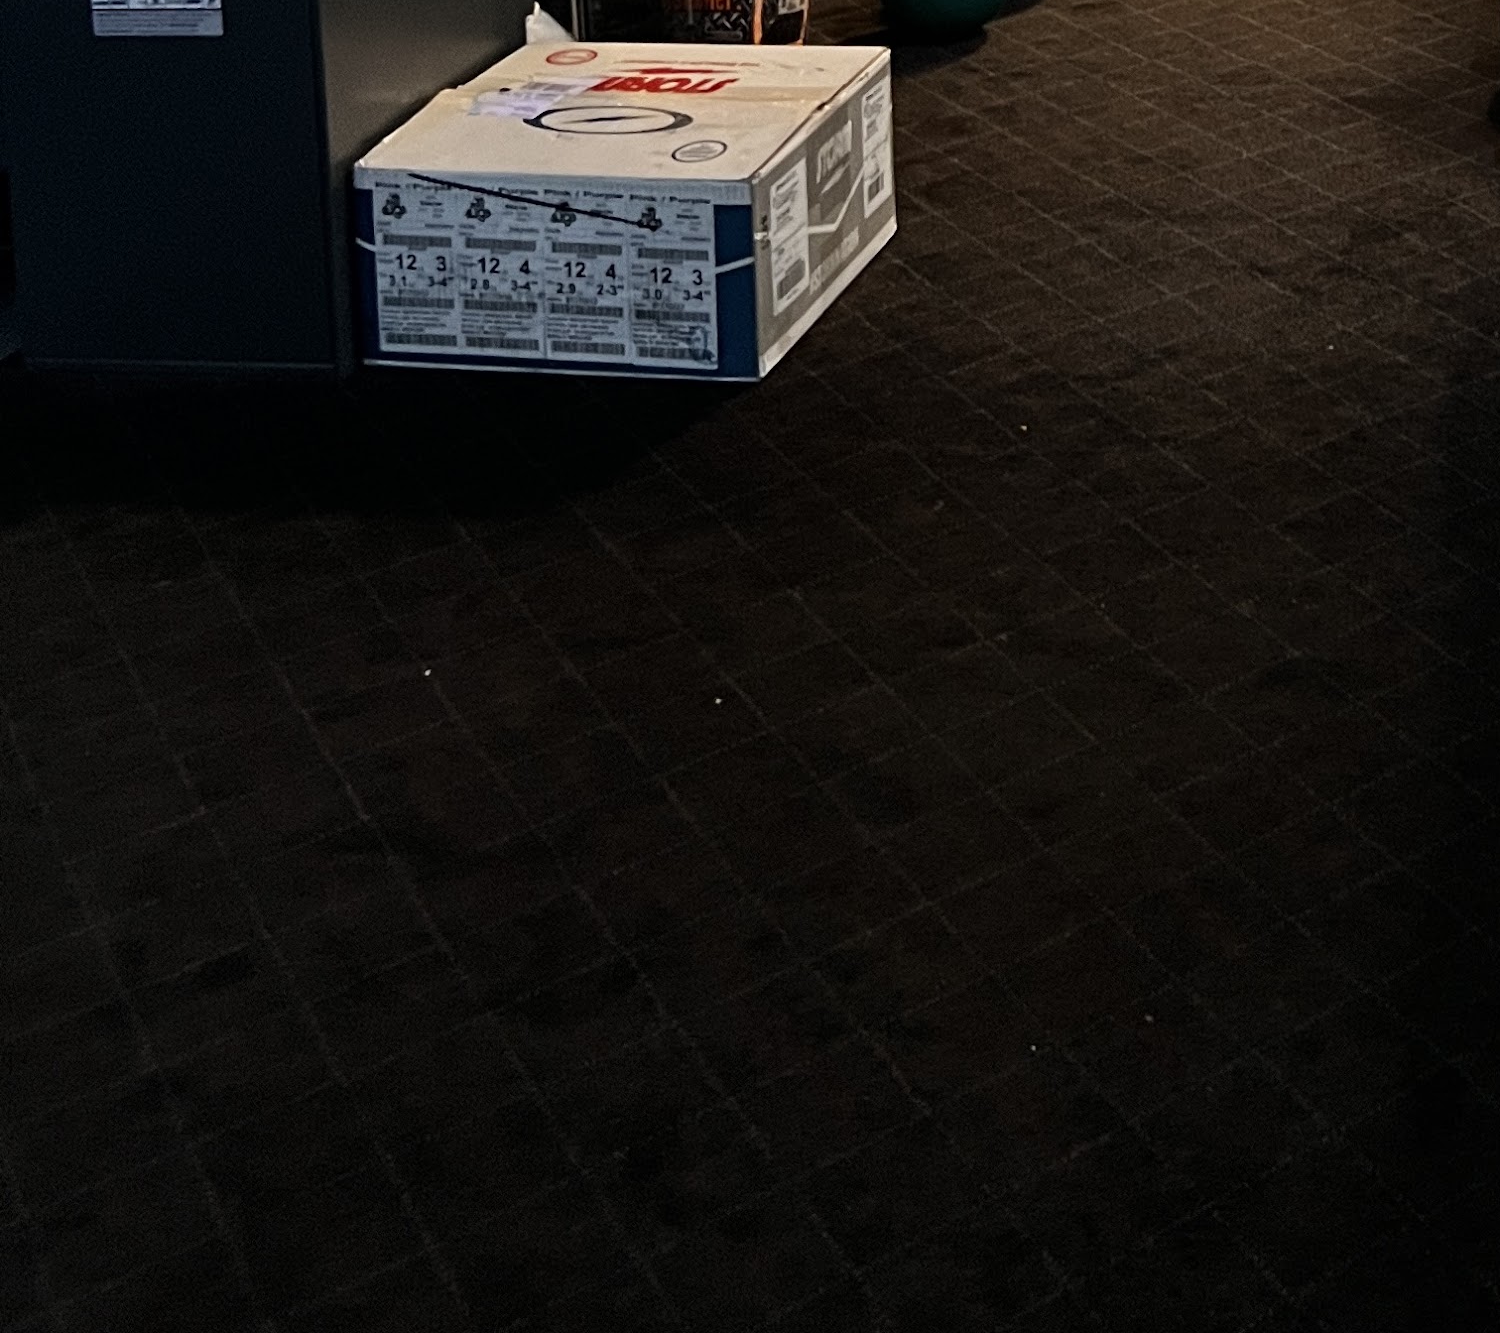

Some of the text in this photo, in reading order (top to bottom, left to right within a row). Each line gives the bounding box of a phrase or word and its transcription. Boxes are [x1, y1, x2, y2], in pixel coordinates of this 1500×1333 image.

[396, 254, 447, 271] 12 3
[478, 257, 531, 275] 12 4
[564, 262, 616, 279] 12 4
[650, 267, 703, 286] 12 3
